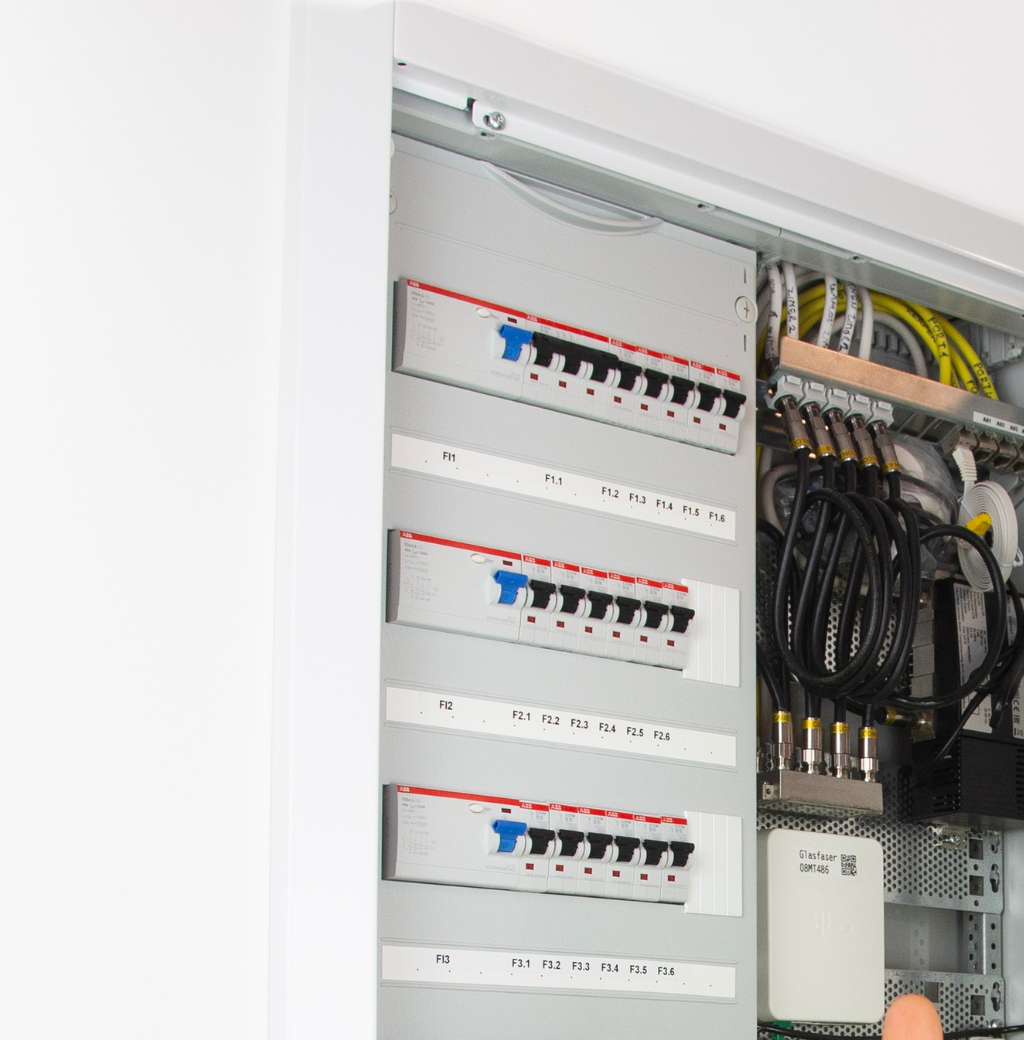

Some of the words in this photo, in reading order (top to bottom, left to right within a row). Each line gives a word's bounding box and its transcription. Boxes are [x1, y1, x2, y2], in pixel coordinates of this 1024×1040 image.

[443, 452, 455, 462] FI1
[546, 474, 562, 486] F1.1
[602, 487, 619, 499] F1.2
[630, 493, 646, 505] F1.3
[657, 499, 672, 511] F1.4
[683, 506, 699, 517] F1.5
[709, 512, 725, 523] F1.6
[553, 561, 565, 569] ABB
[609, 573, 621, 581] ABB
[637, 577, 649, 585] ABB
[663, 582, 675, 590] ABB
[440, 700, 452, 711] FI2
[513, 711, 530, 721] F2.1
[543, 715, 559, 726] F2.2
[571, 719, 588, 730] F2.3
[599, 723, 616, 733] F2.4
[627, 727, 643, 738] F2.5
[654, 731, 670, 741] F2.6
[662, 816, 674, 824] ABB
[799, 849, 837, 862] Glasfaser
[437, 955, 450, 965] FI3
[512, 959, 529, 968] F3.1
[543, 960, 560, 970] F3.2
[573, 962, 590, 972] F3.3
[602, 963, 618, 973] F3.4
[630, 965, 647, 975] F3.5
[658, 967, 674, 976] F3.6
